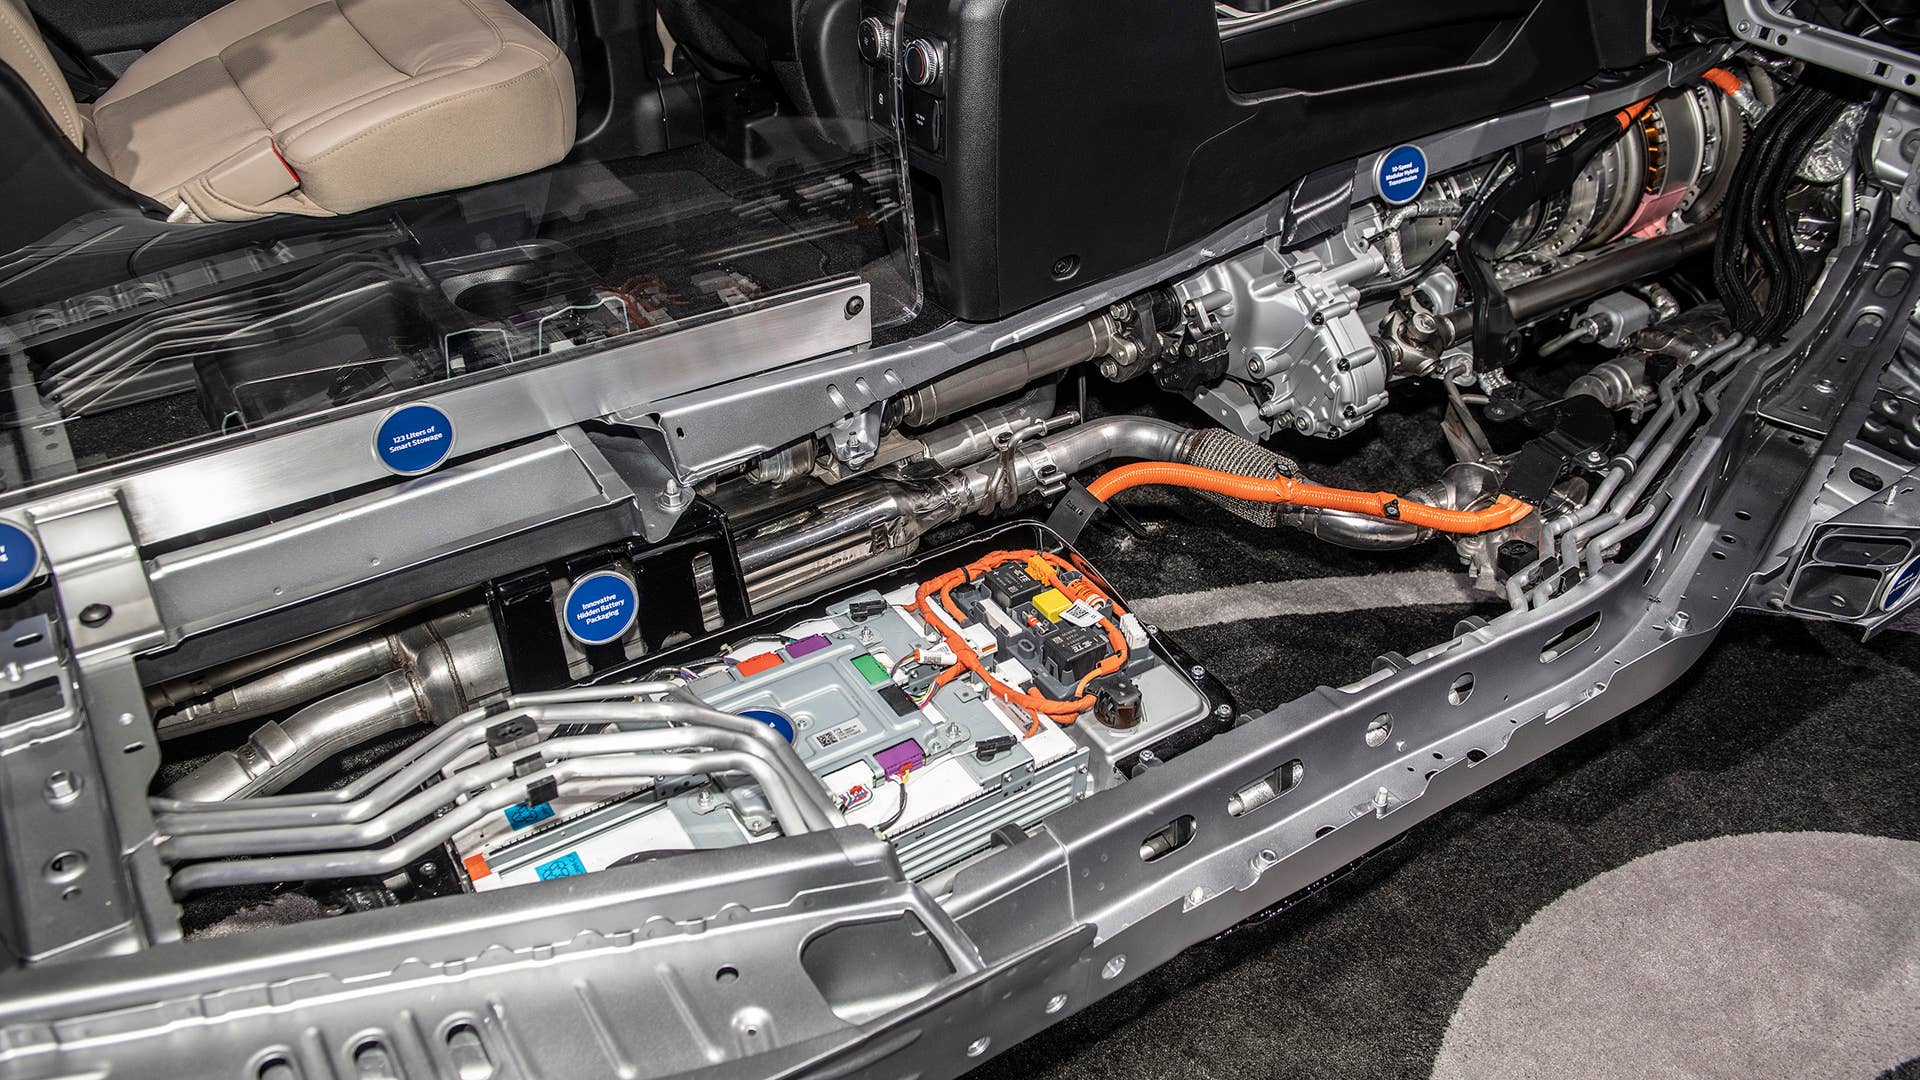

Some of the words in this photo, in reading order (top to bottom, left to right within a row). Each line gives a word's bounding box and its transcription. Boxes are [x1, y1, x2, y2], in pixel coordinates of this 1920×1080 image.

[1385, 172, 1404, 181] Modular
[1404, 167, 1419, 176] Hybrid
[1392, 162, 1412, 172] 10-Speed
[1388, 175, 1418, 186] Transmission
[393, 435, 405, 443] 123
[405, 430, 427, 440] Liters
[427, 425, 435, 433] of
[389, 442, 412, 453] Smart
[411, 433, 443, 446] Stowage
[577, 609, 601, 620] Hidden
[600, 599, 625, 611] Battery
[582, 594, 617, 610] Innovative
[586, 609, 620, 625] Packaging
